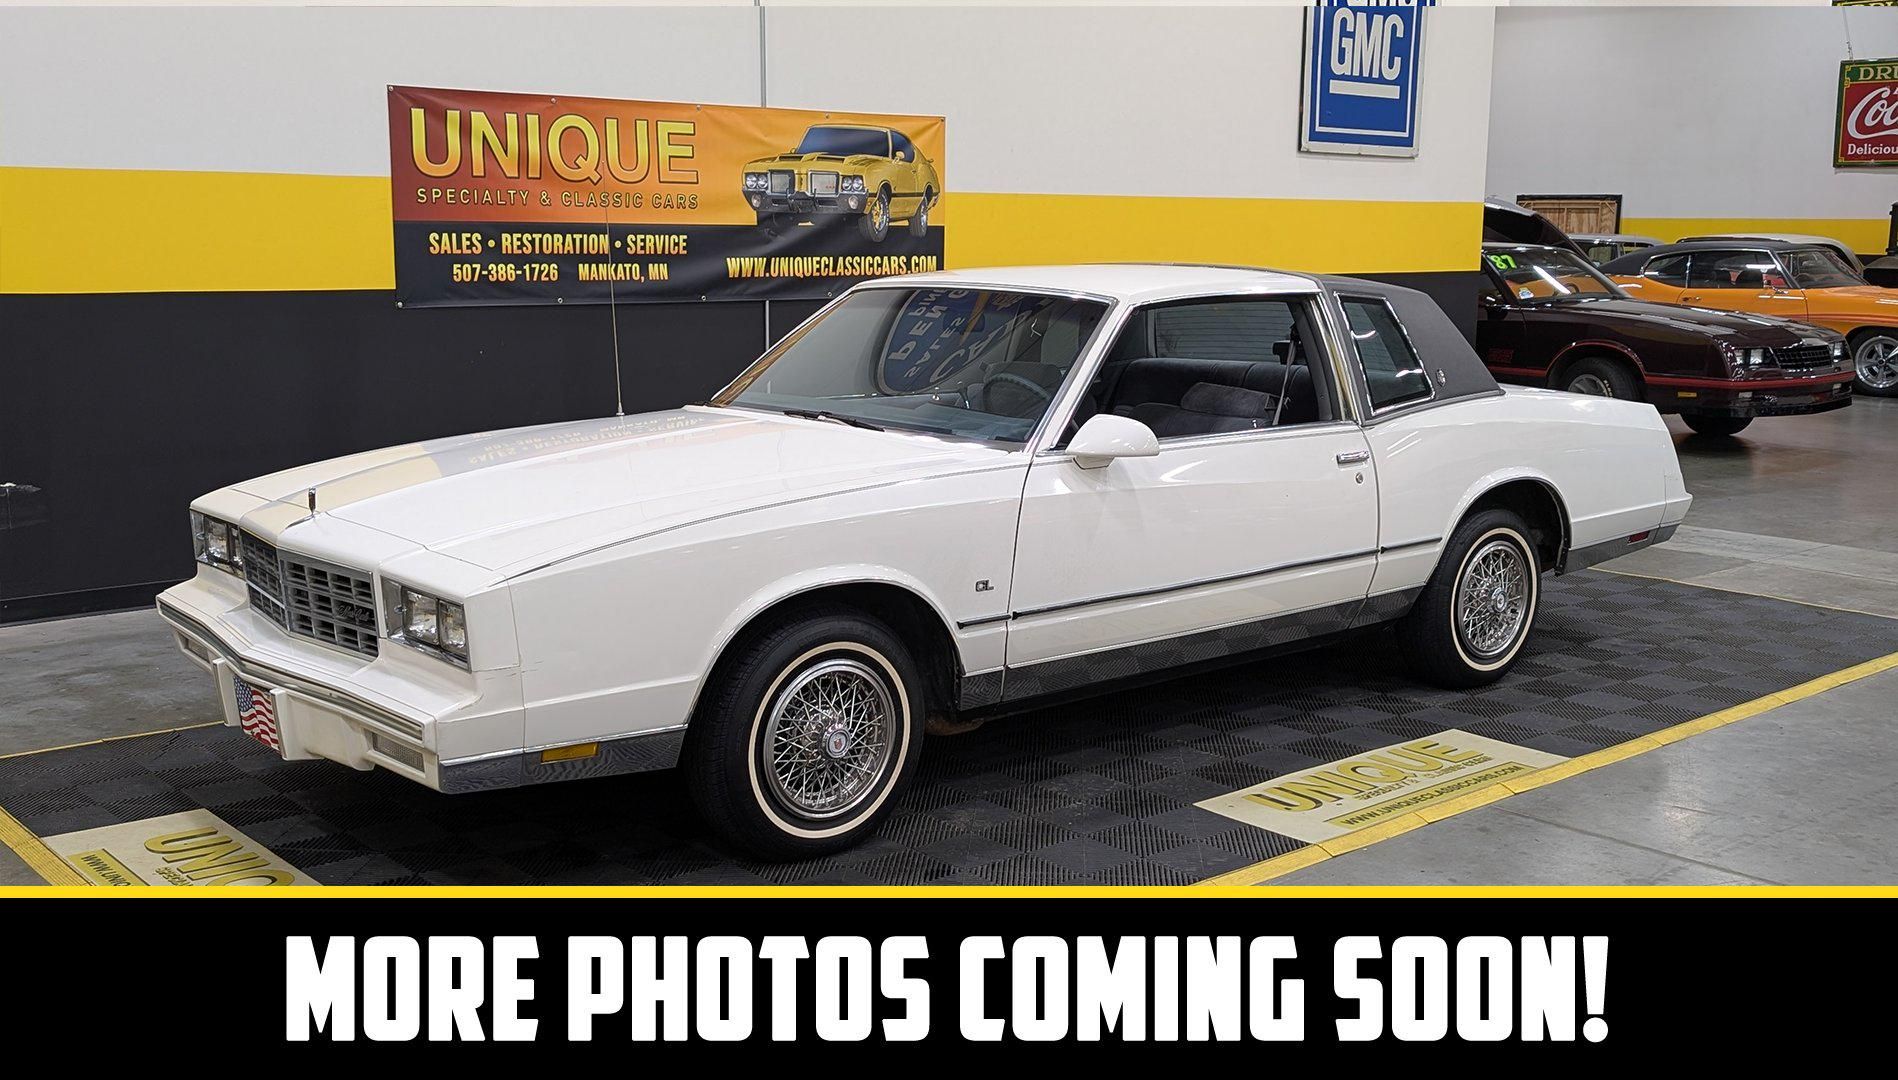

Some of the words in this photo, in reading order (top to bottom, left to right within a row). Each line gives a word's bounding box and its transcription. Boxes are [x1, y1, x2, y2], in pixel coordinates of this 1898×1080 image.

[1330, 7, 1404, 80] GMC
[410, 107, 699, 186] UNIQUE
[416, 187, 529, 205] SPECIALTY
[540, 190, 551, 206] &
[561, 191, 643, 208] CLASSIC
[652, 193, 699, 209] CARS
[429, 232, 482, 254] SALES
[501, 233, 609, 254] RESTORATION
[626, 234, 688, 255] SERVICE
[452, 263, 559, 282] 507-386-1726
[578, 263, 645, 283] MANKATO,
[648, 263, 669, 280] MN
[726, 255, 937, 278] WWW.UNIQUECLASSICCARS.COM
[1241, 740, 1484, 812] UNIQUE
